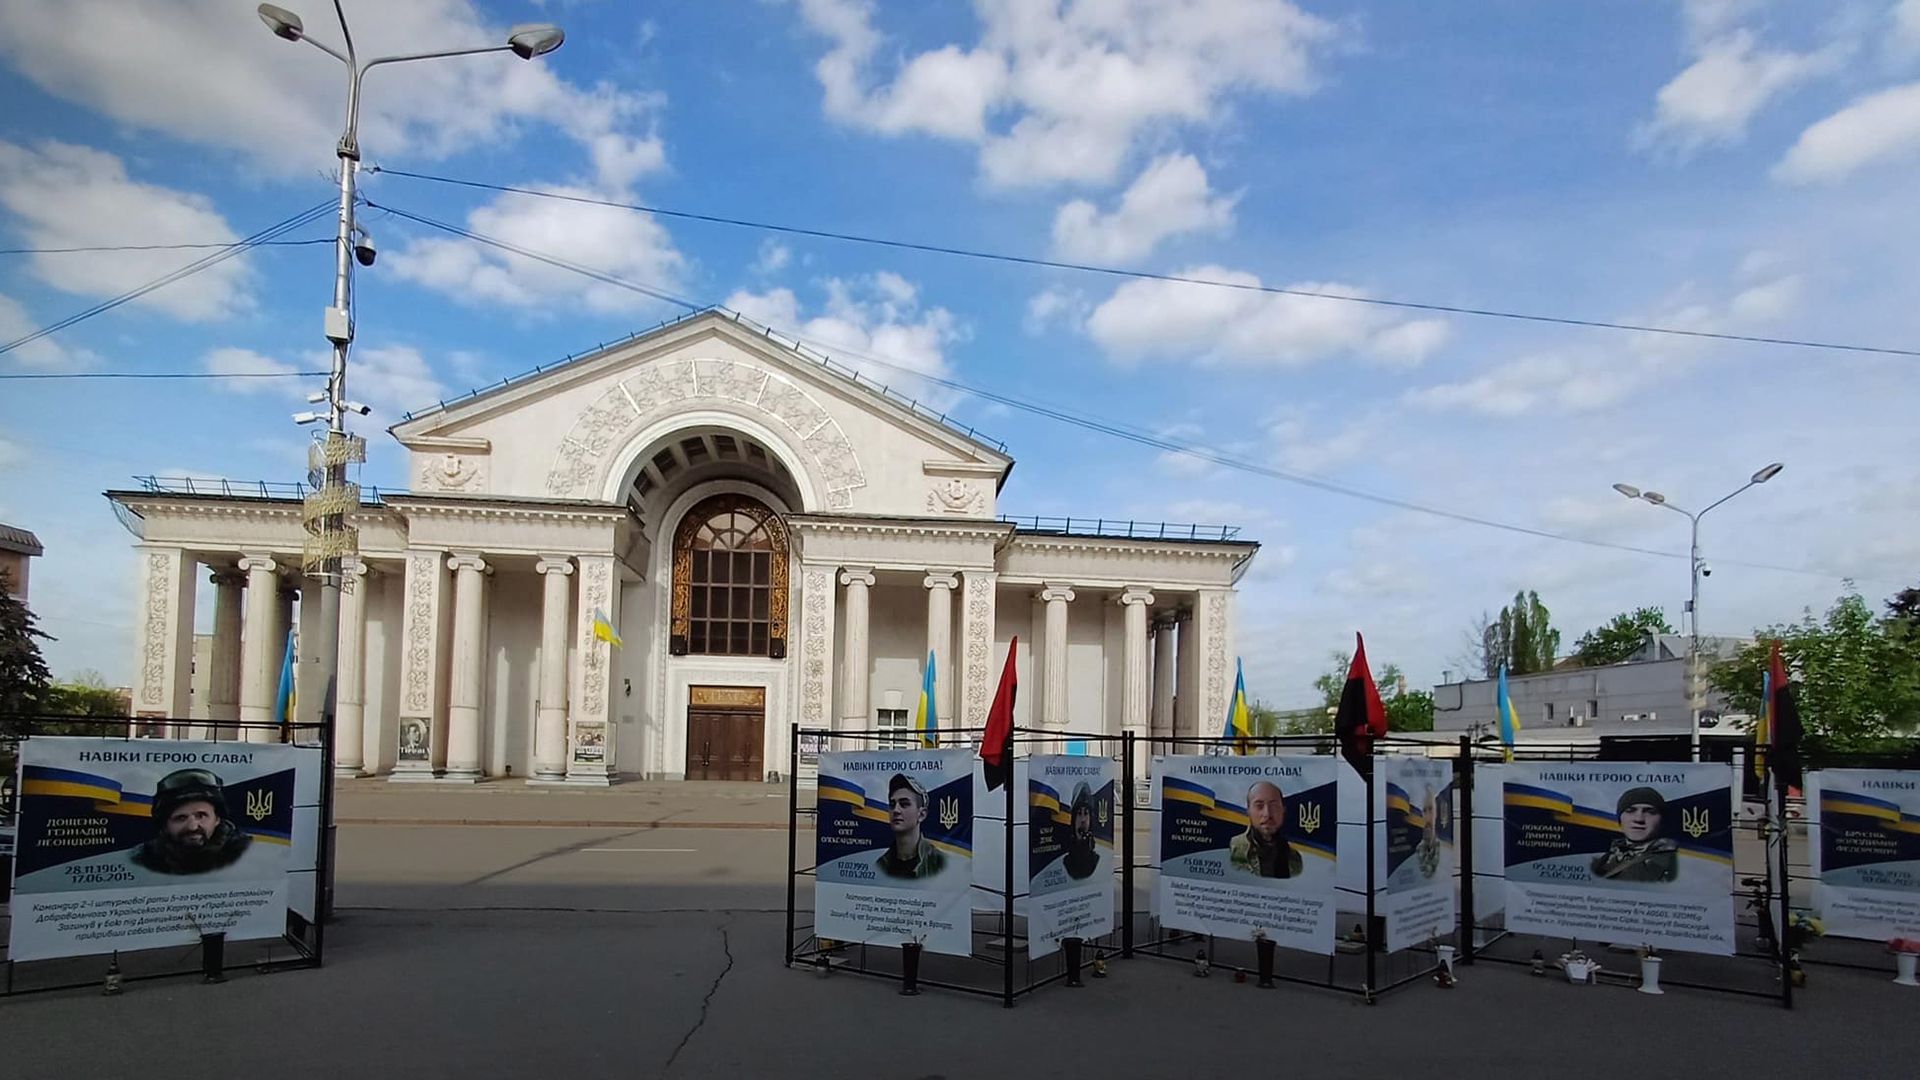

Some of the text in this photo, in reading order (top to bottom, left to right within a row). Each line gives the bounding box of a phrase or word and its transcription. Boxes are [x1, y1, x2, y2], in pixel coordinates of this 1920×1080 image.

[79, 751, 253, 764] НАВІКИ ГЕРОЮ СЛАВА!
[843, 760, 943, 771] НАВІКИ ГЕРОЮ СЛАВА!
[1190, 766, 1302, 776] НАВІКИ ГЕРОЮ СЛАВА!
[1539, 772, 1685, 784] НАВІКИ ГЕРОЮ СЛАВА!
[1862, 780, 1915, 790] НАВІКИ
[71, 871, 136, 884] 17.06.2015
